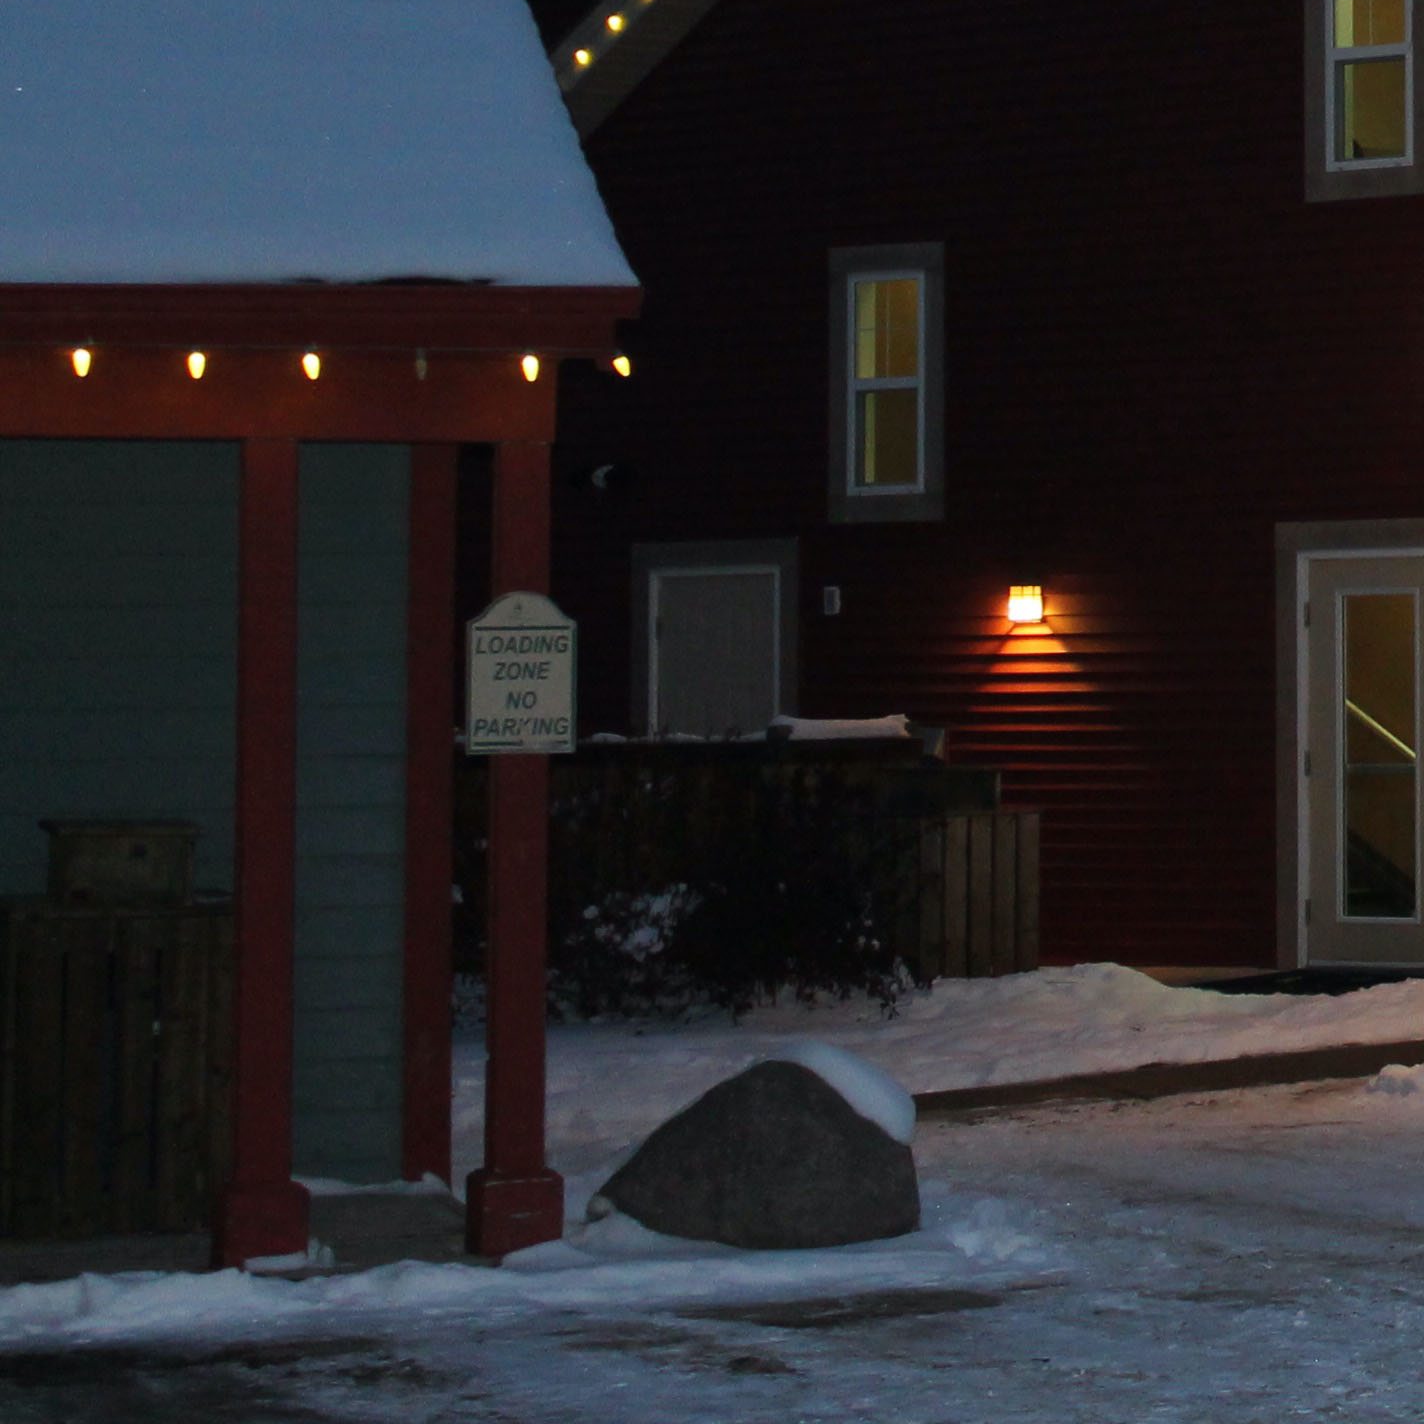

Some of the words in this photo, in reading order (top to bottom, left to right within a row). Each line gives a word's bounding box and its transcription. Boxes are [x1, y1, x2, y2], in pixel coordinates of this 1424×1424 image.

[475, 635, 569, 655] LOADING
[493, 661, 550, 681] ZONE
[505, 691, 537, 709] NO
